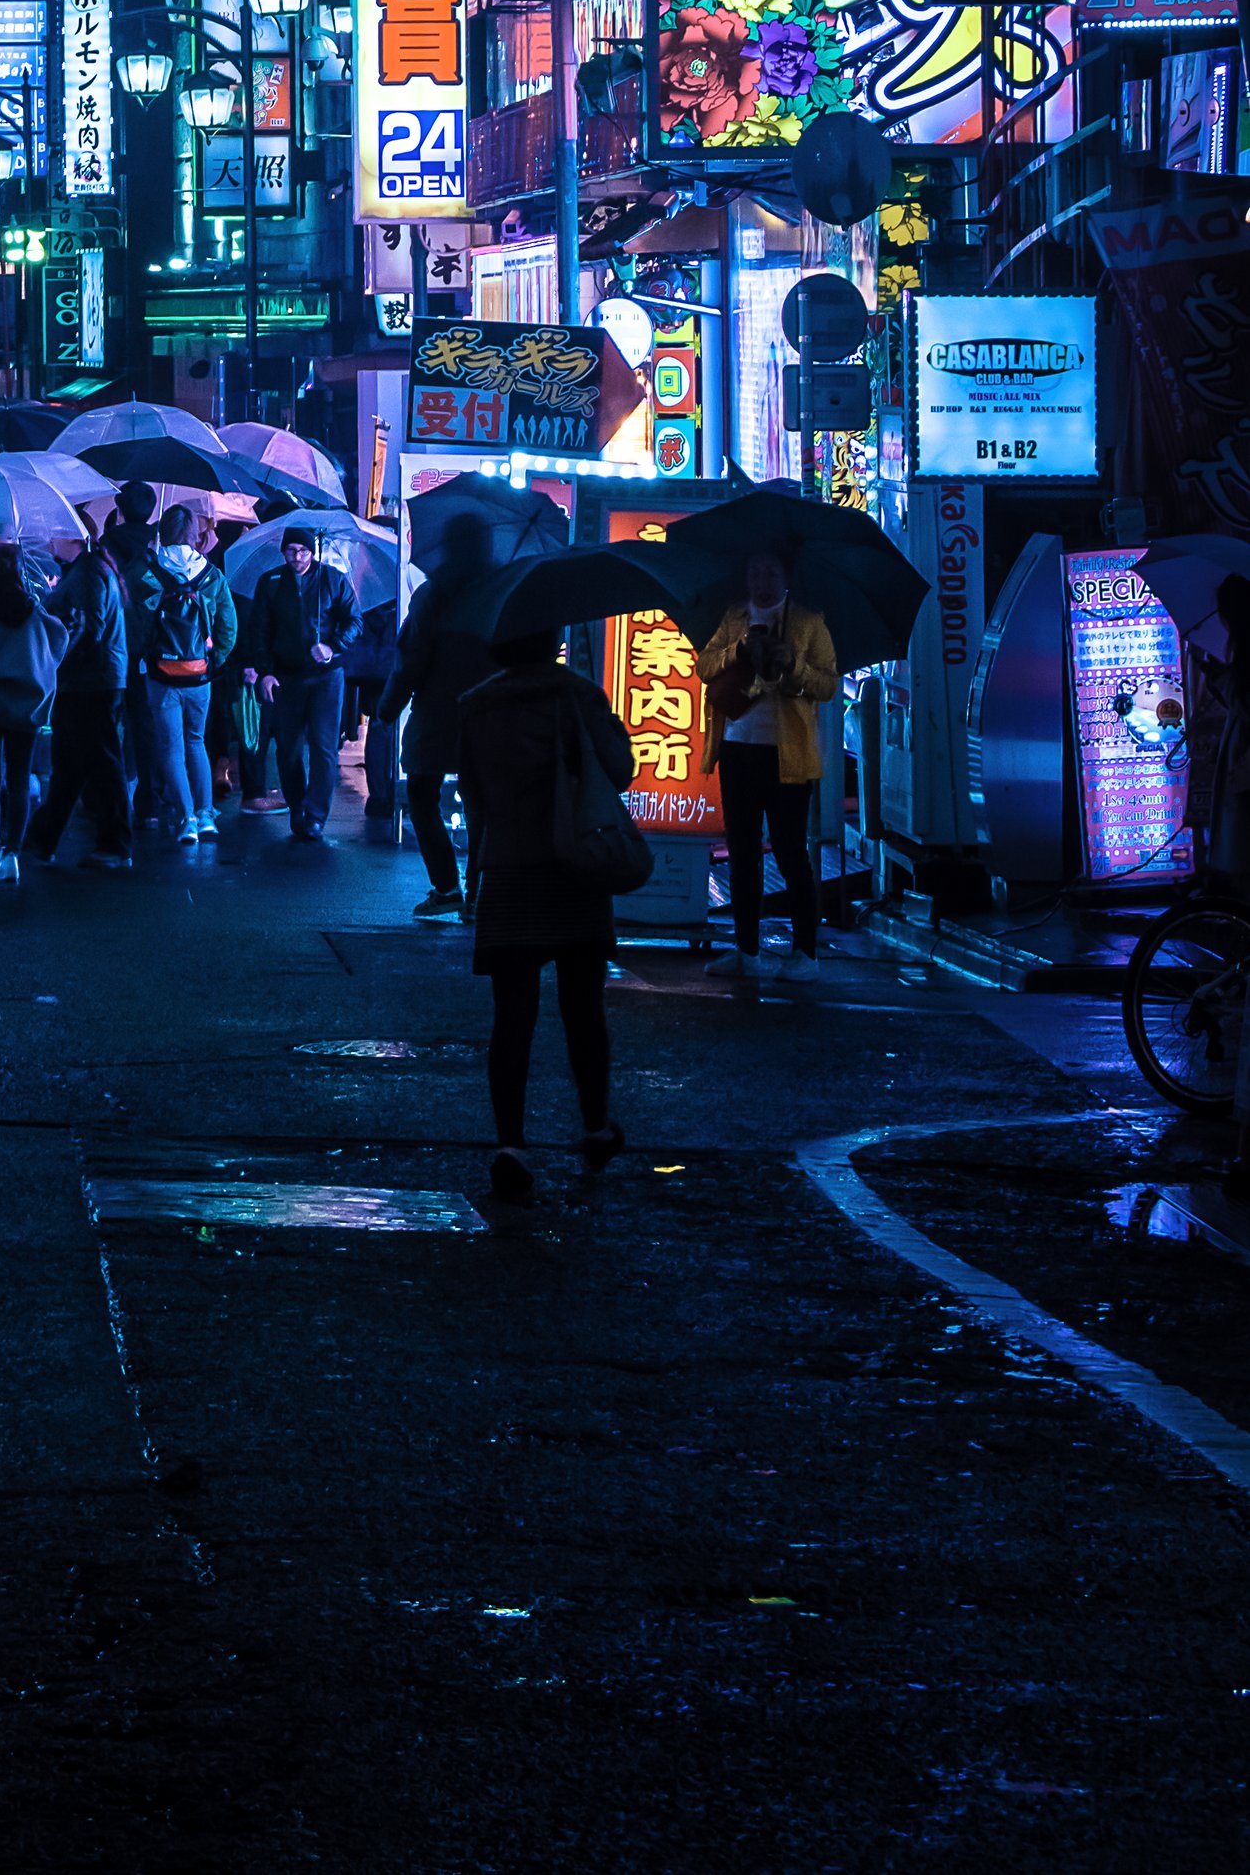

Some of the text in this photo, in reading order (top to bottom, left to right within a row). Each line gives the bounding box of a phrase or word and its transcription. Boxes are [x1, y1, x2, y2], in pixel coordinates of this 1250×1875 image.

[380, 110, 462, 173] 24
[381, 174, 462, 197] OPEN
[417, 327, 598, 388] ギラギラ
[929, 342, 1082, 371] CASABLANCA
[482, 363, 599, 418] ガールズ
[975, 373, 1035, 385] CLUB & BAR
[416, 389, 505, 441] 受付
[930, 405, 945, 413] HIP
[976, 439, 1038, 459] B1 & B2
[997, 461, 1017, 470] Floor
